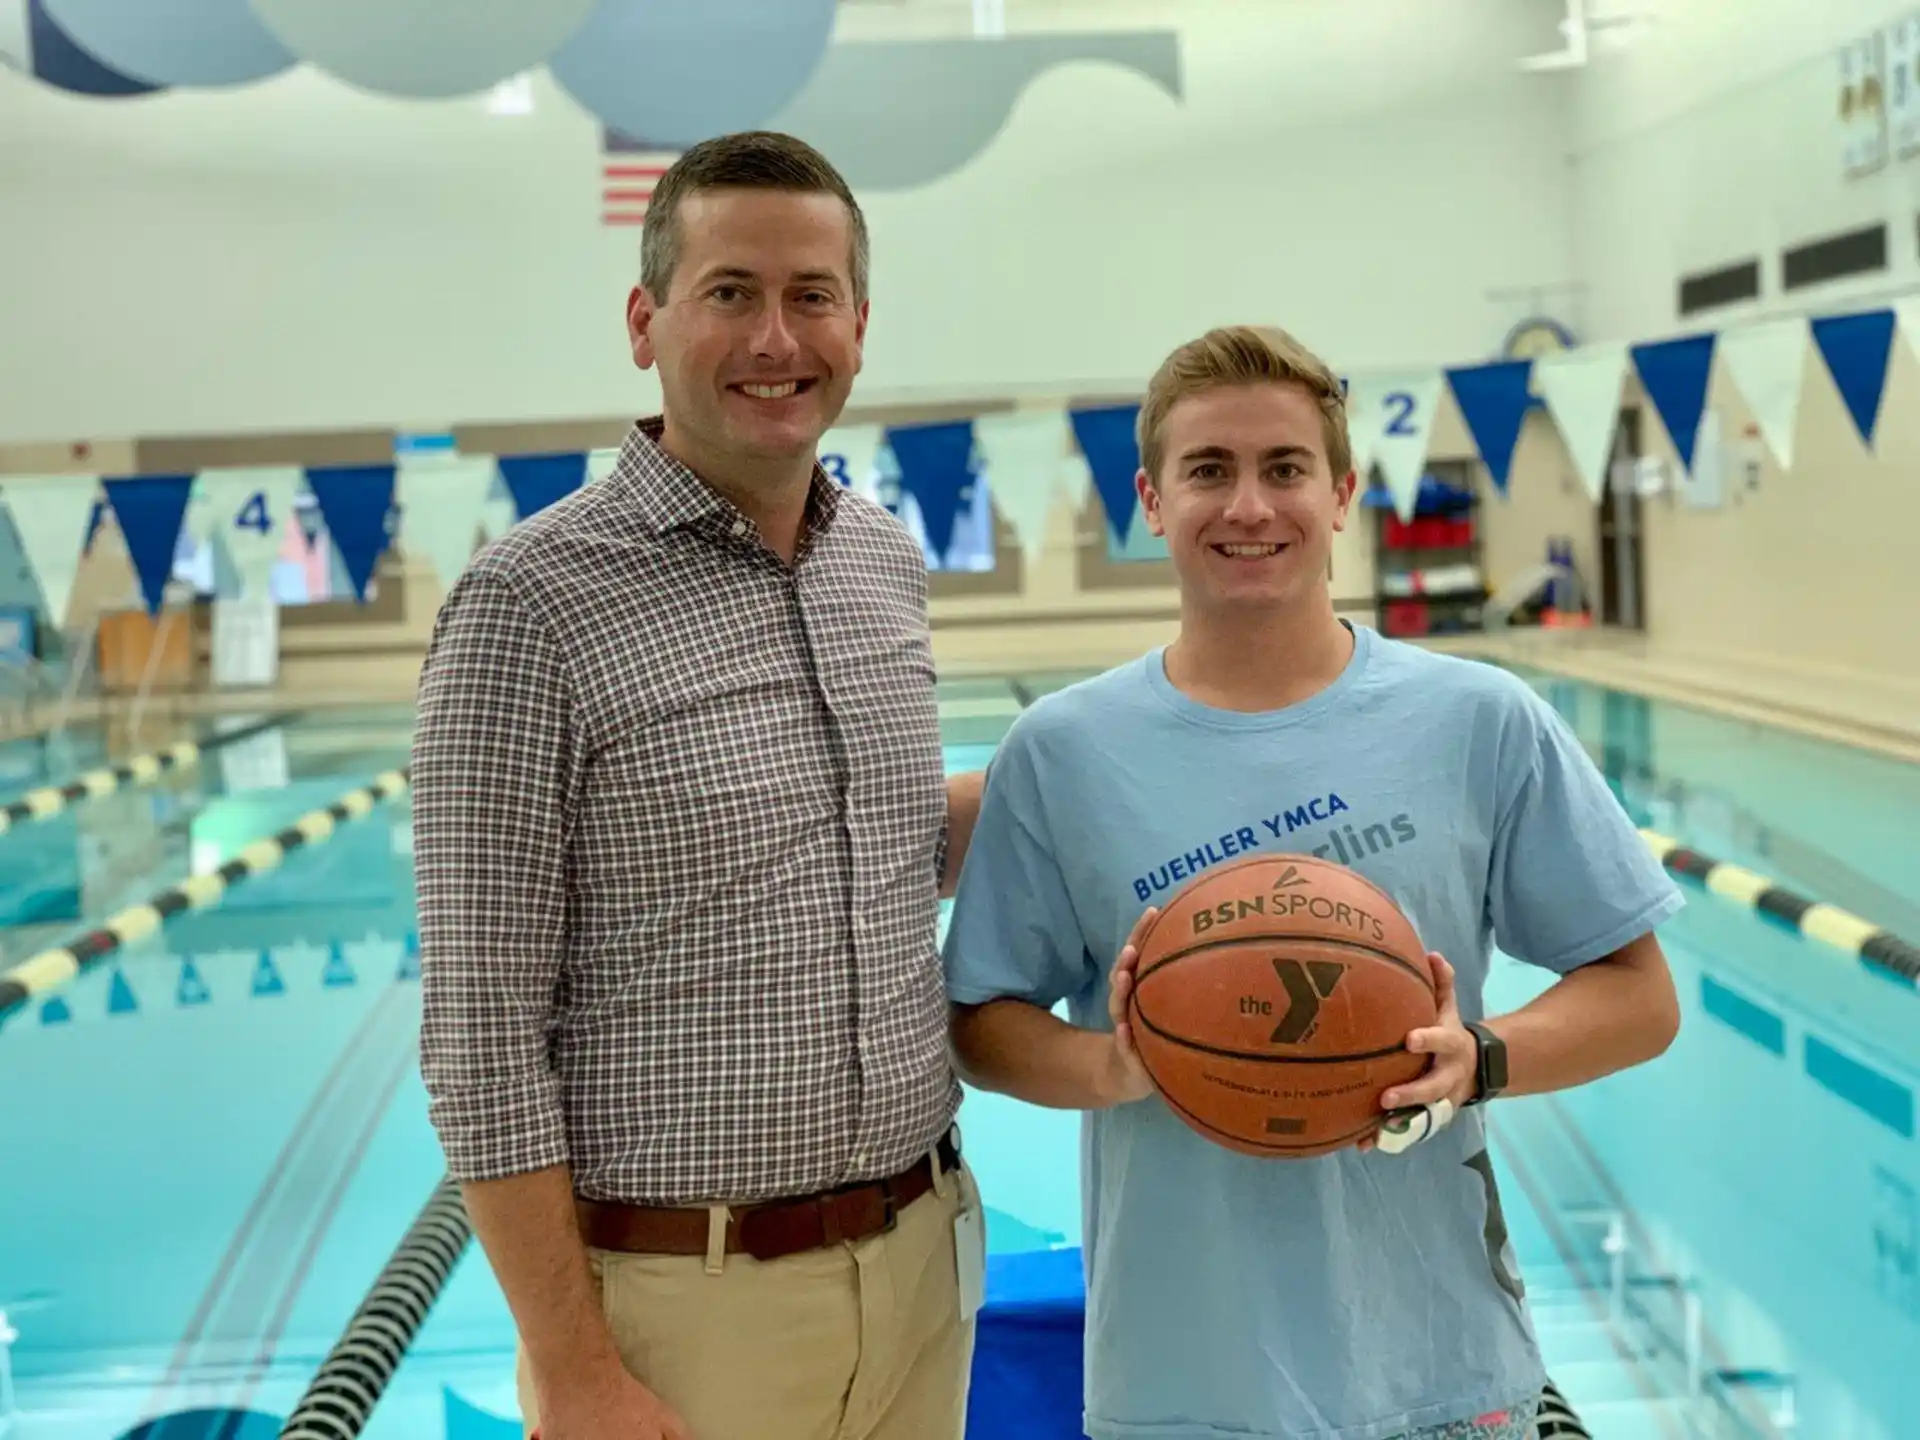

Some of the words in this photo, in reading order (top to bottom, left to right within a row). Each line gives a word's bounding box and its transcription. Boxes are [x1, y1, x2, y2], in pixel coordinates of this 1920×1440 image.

[1383, 391, 1420, 437] 2
[820, 453, 851, 488] 3
[233, 491, 274, 536] 4
[1132, 826, 1260, 902] BUEHLER
[1261, 792, 1349, 838] YMCA
[1312, 813, 1416, 866] rlins
[1192, 895, 1264, 935] BSN
[1272, 894, 1384, 941] SPORTS
[1239, 995, 1272, 1016] the
